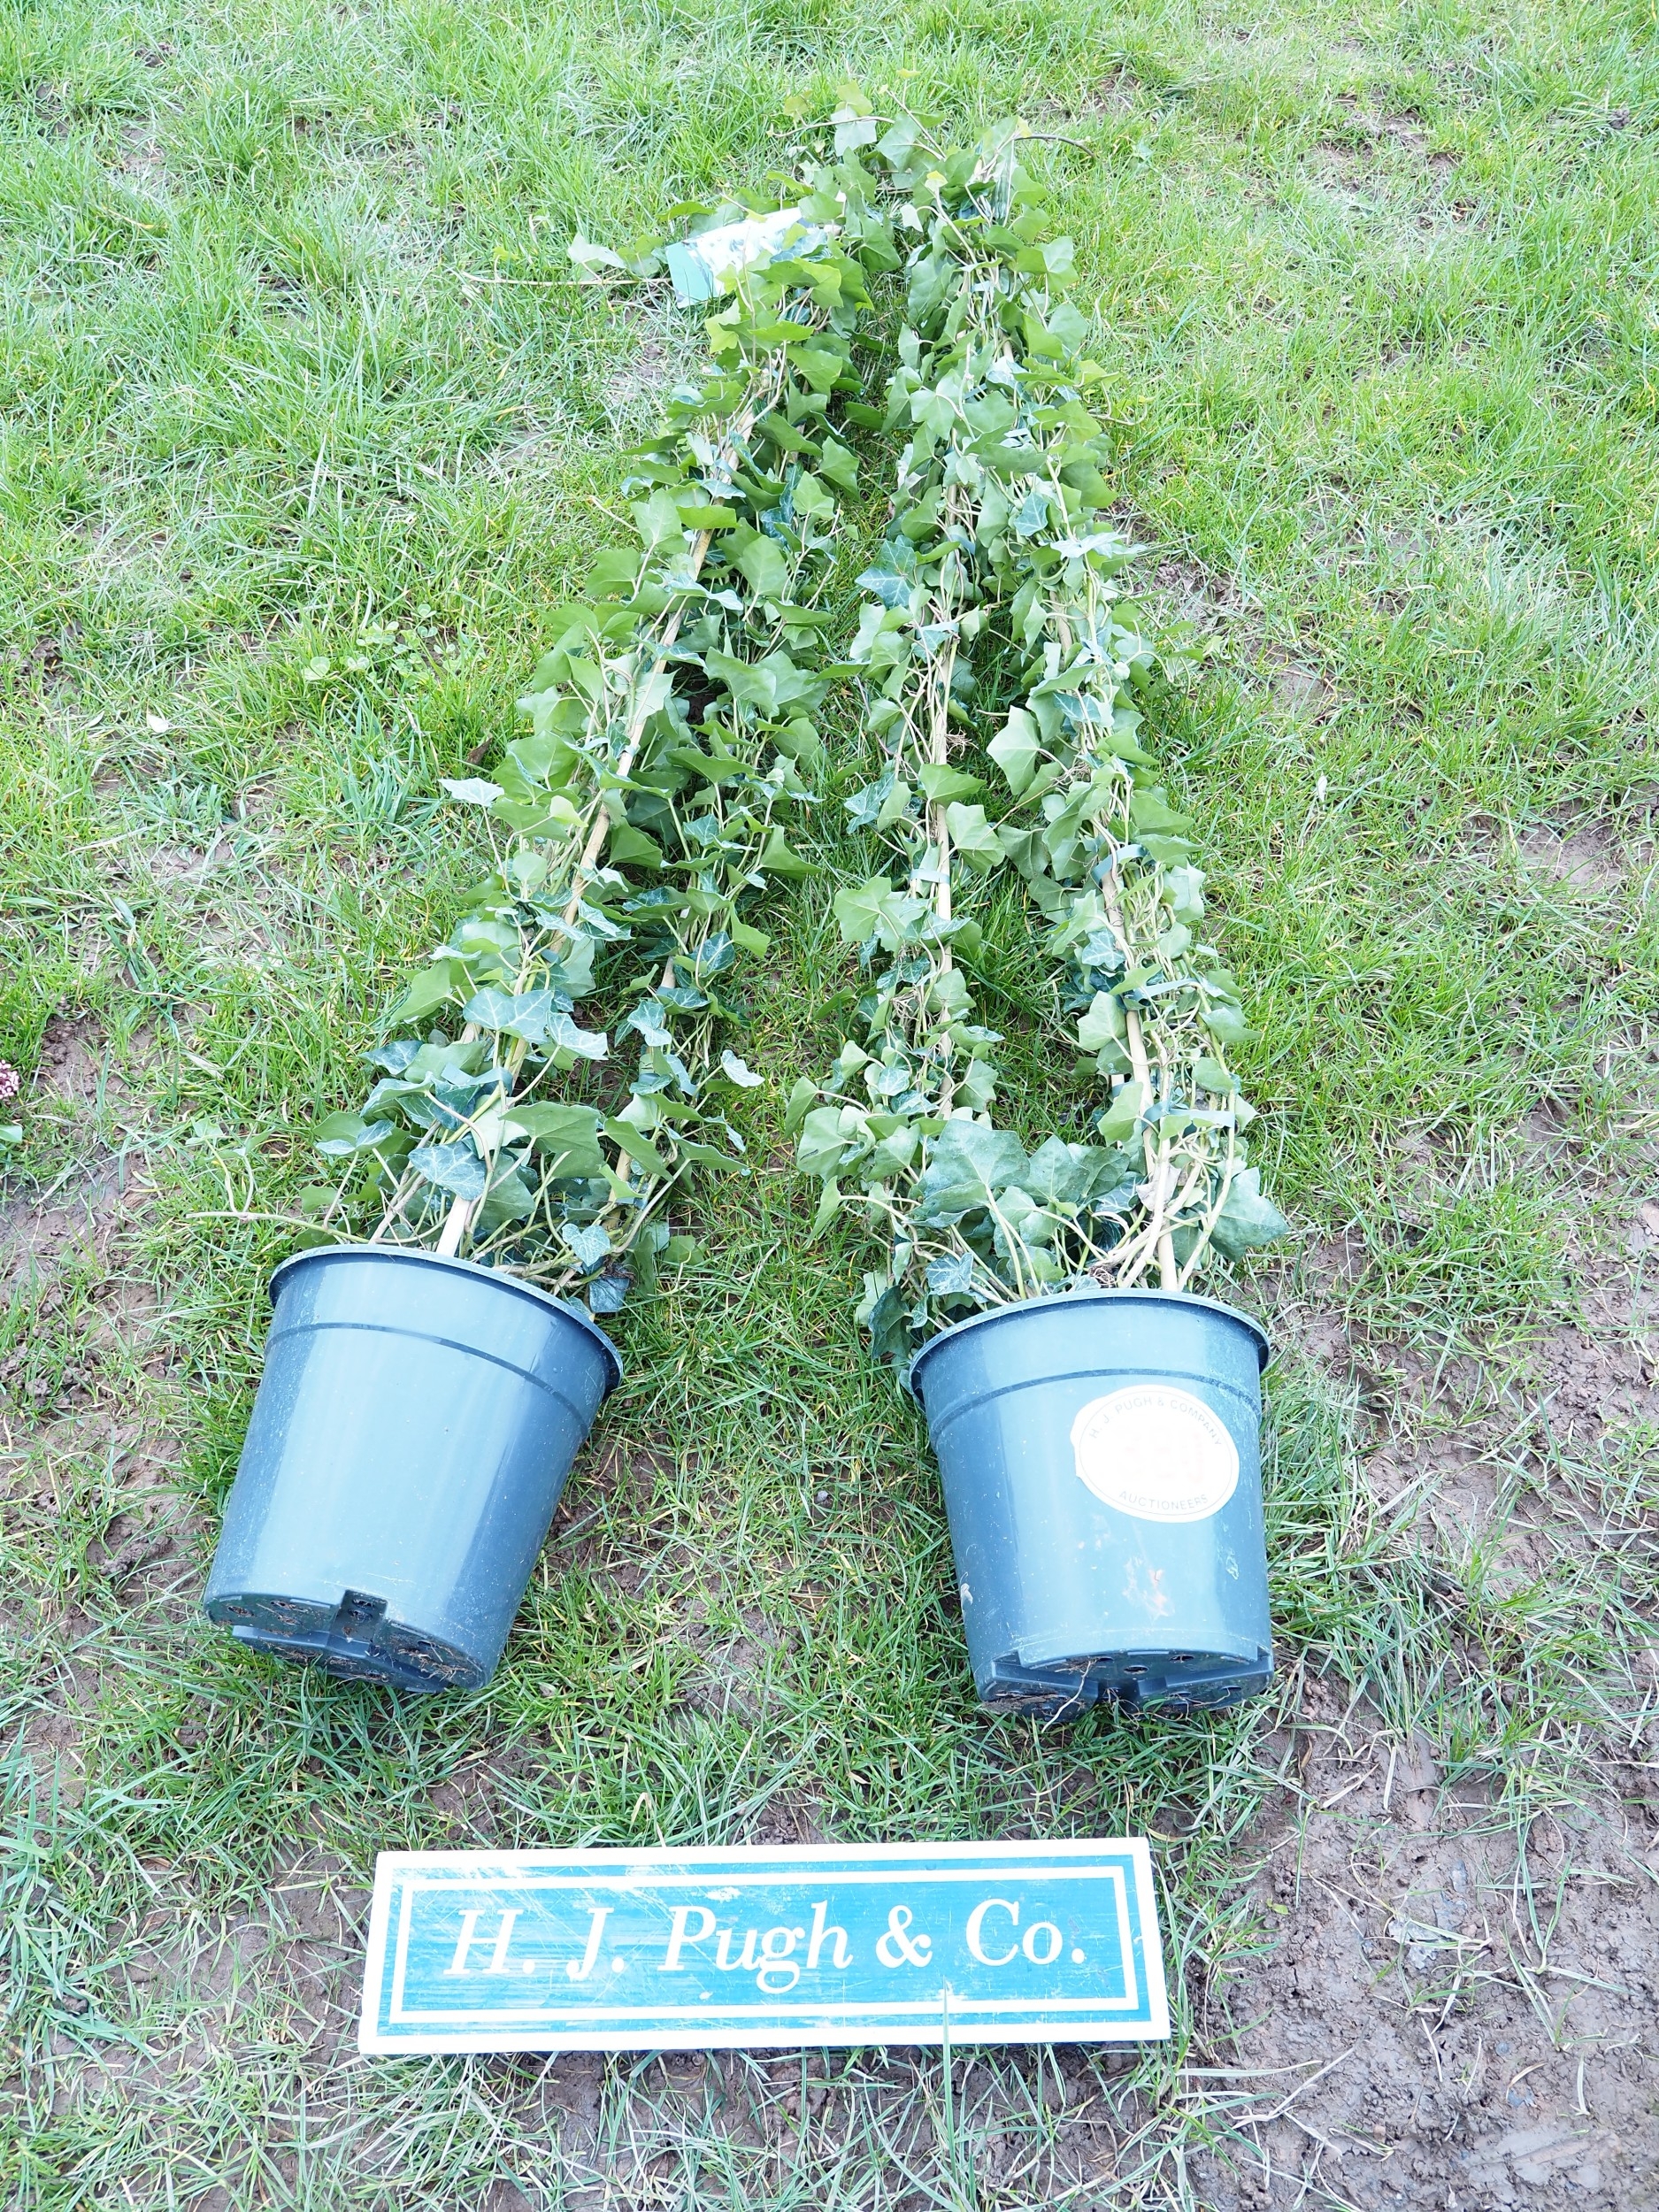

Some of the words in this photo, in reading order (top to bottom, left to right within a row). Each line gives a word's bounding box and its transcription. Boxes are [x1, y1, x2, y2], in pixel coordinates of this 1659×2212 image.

[1115, 1396, 1152, 1415] PUGH
[1157, 1396, 1164, 1407] &
[1171, 1399, 1222, 1446] COMPANY
[1119, 1490, 1209, 1510] AUCTIONEERS
[443, 1908, 538, 1976] H.
[565, 1906, 626, 1981] J.
[657, 1900, 853, 1994] Pugh
[879, 1904, 933, 1969] &
[965, 1897, 1087, 1967] Co.
